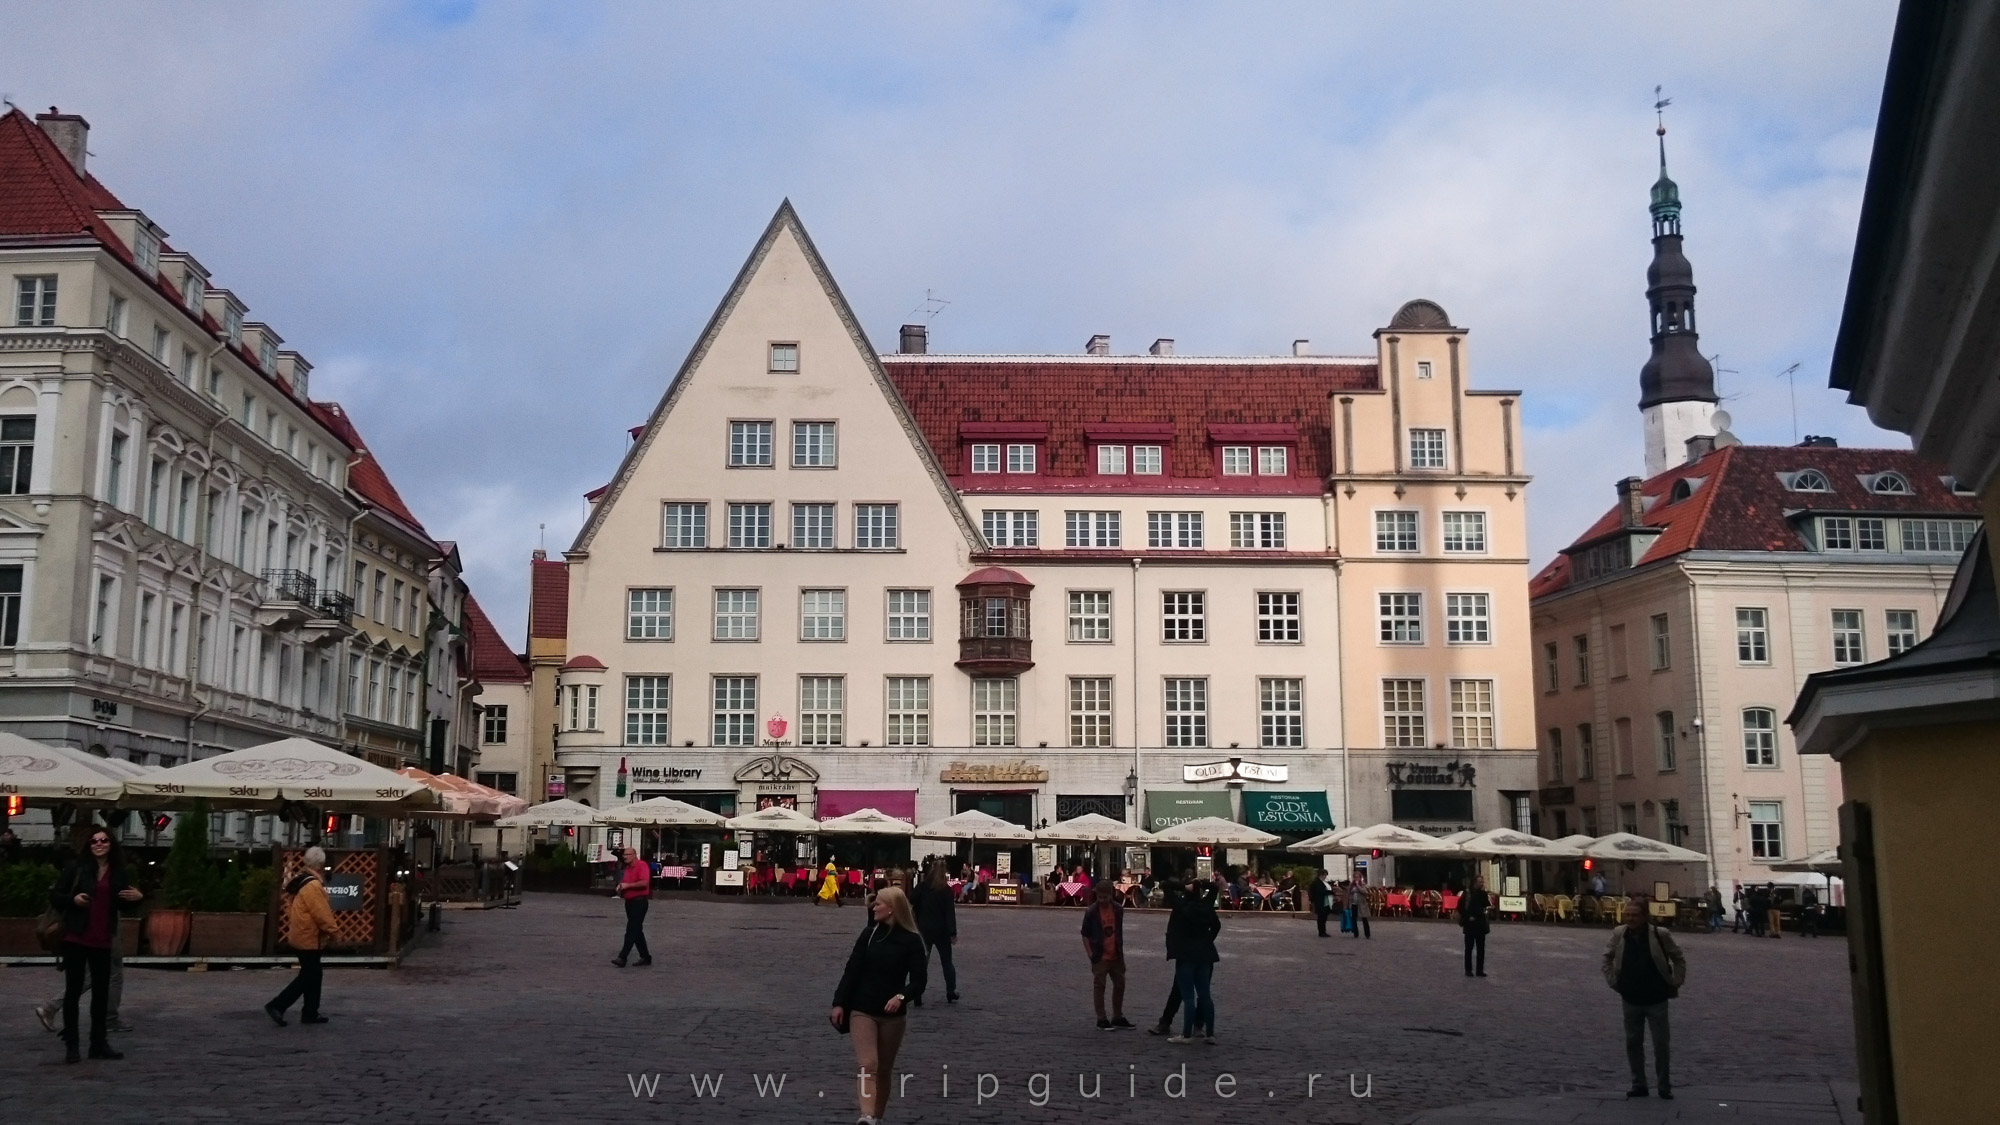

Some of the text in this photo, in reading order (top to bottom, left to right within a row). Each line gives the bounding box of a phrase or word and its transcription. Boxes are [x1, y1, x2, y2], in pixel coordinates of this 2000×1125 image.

[632, 767, 702, 780] Wine Library
[64, 785, 97, 796] saku
[154, 783, 185, 793] saku
[229, 785, 259, 796] saku
[303, 787, 333, 798] saku
[375, 787, 405, 798] saku
[1265, 801, 1309, 813] OLDE
[1257, 811, 1323, 822] ESTONIA
